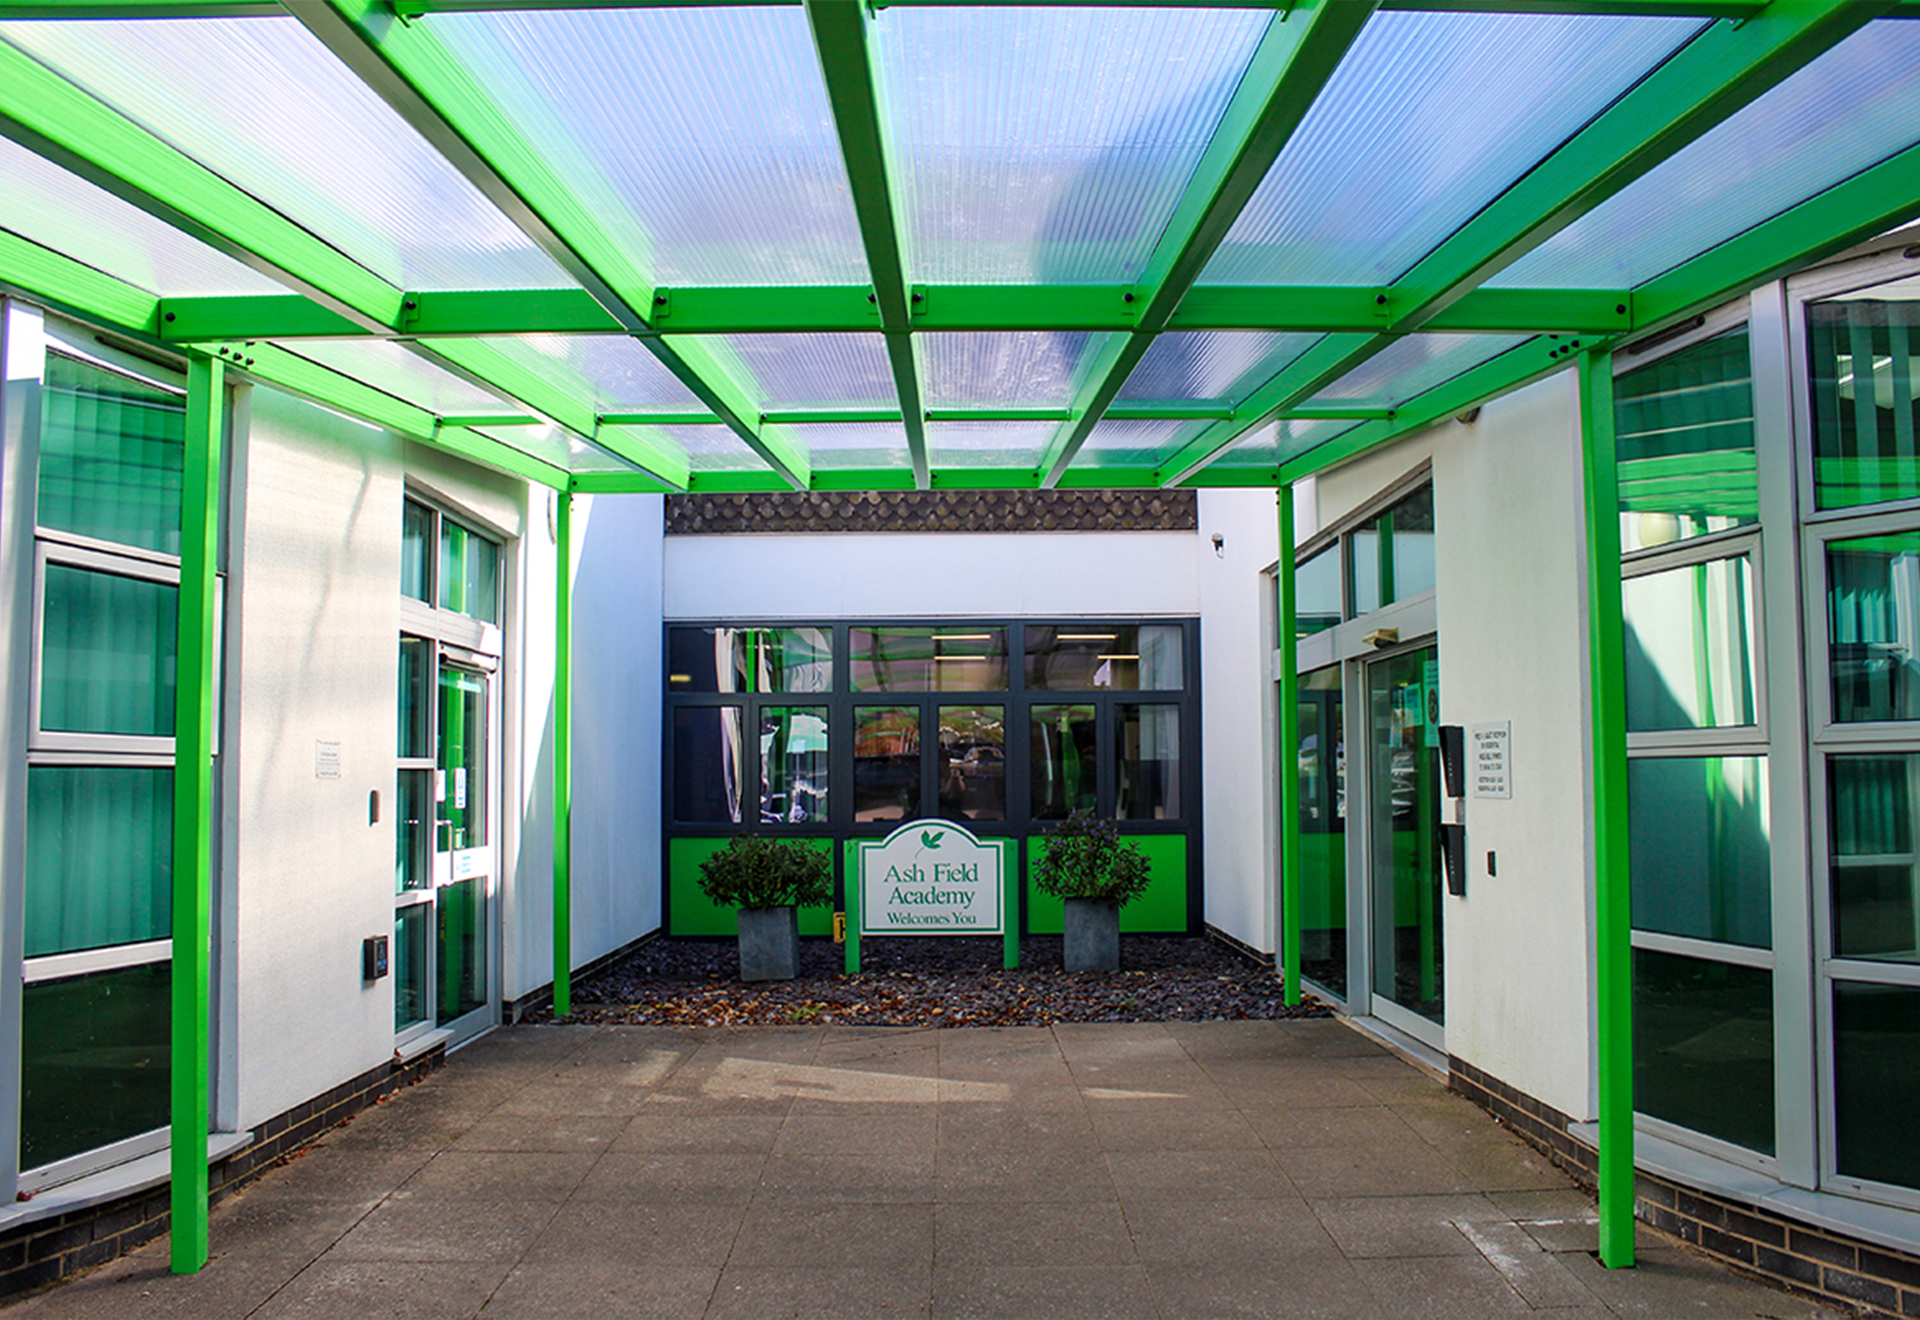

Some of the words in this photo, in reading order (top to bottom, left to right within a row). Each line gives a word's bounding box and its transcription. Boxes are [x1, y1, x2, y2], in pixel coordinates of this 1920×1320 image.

[884, 863, 925, 883] Ash
[933, 863, 979, 883] Field
[888, 886, 975, 909] Academy
[887, 912, 950, 925] Welcomes
[952, 912, 977, 925] You
